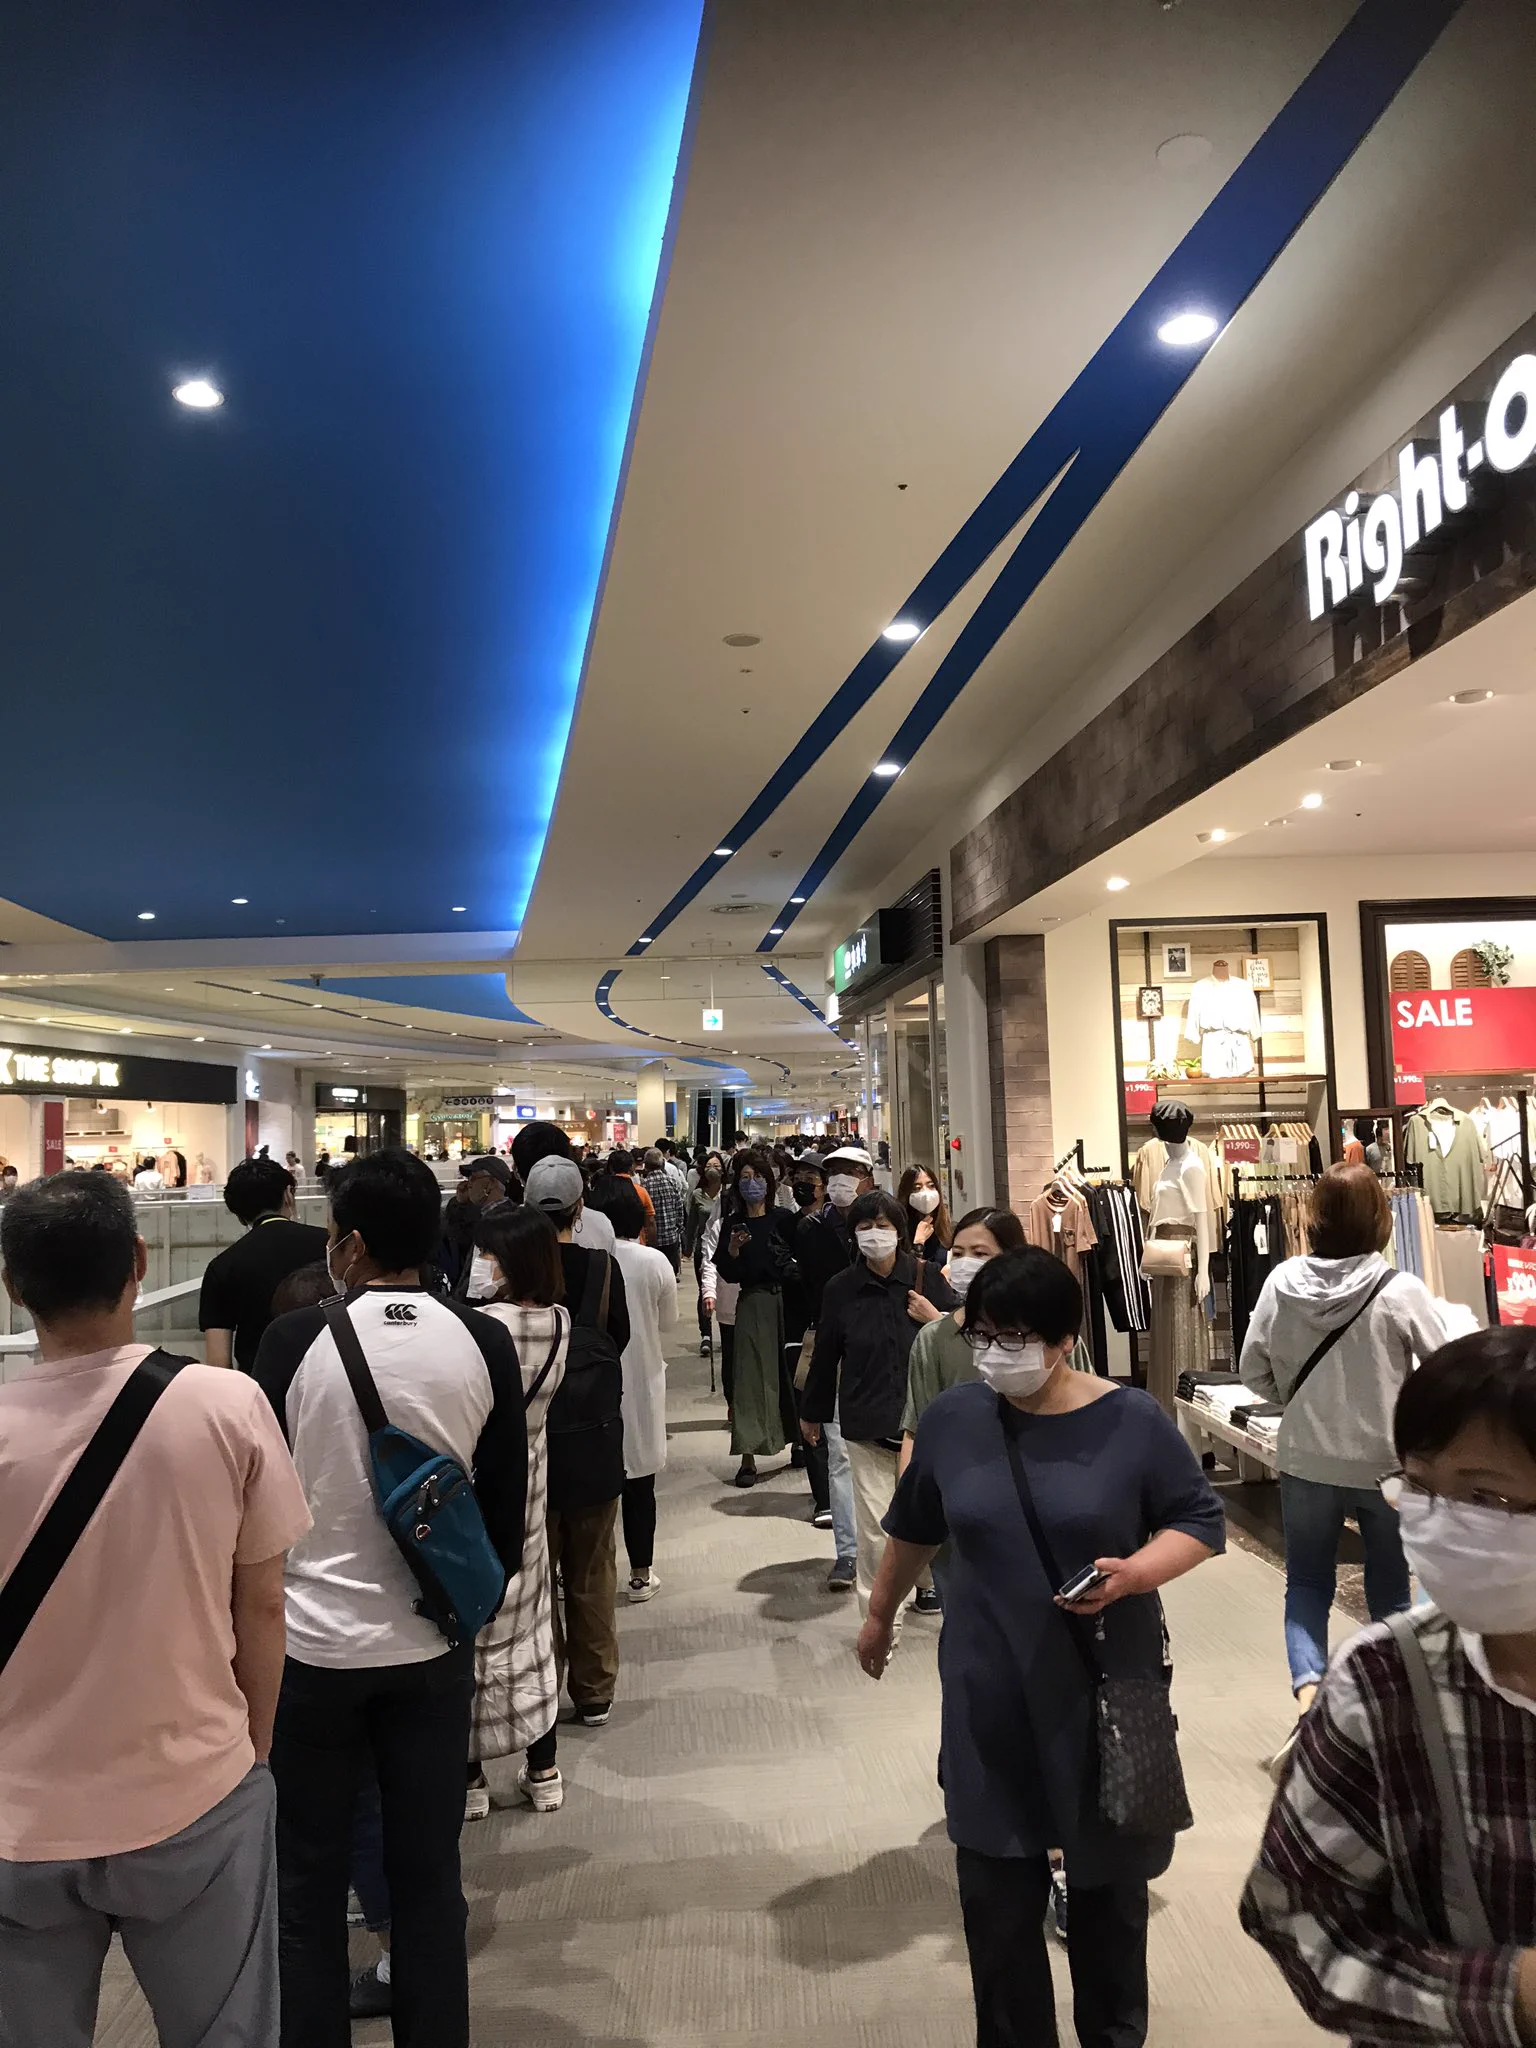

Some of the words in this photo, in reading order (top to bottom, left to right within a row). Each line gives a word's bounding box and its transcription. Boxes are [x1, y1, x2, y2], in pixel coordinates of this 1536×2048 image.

[1397, 998, 1473, 1029] SALE
[13, 1054, 50, 1082] THE
[46, 1139, 62, 1150] SALE
